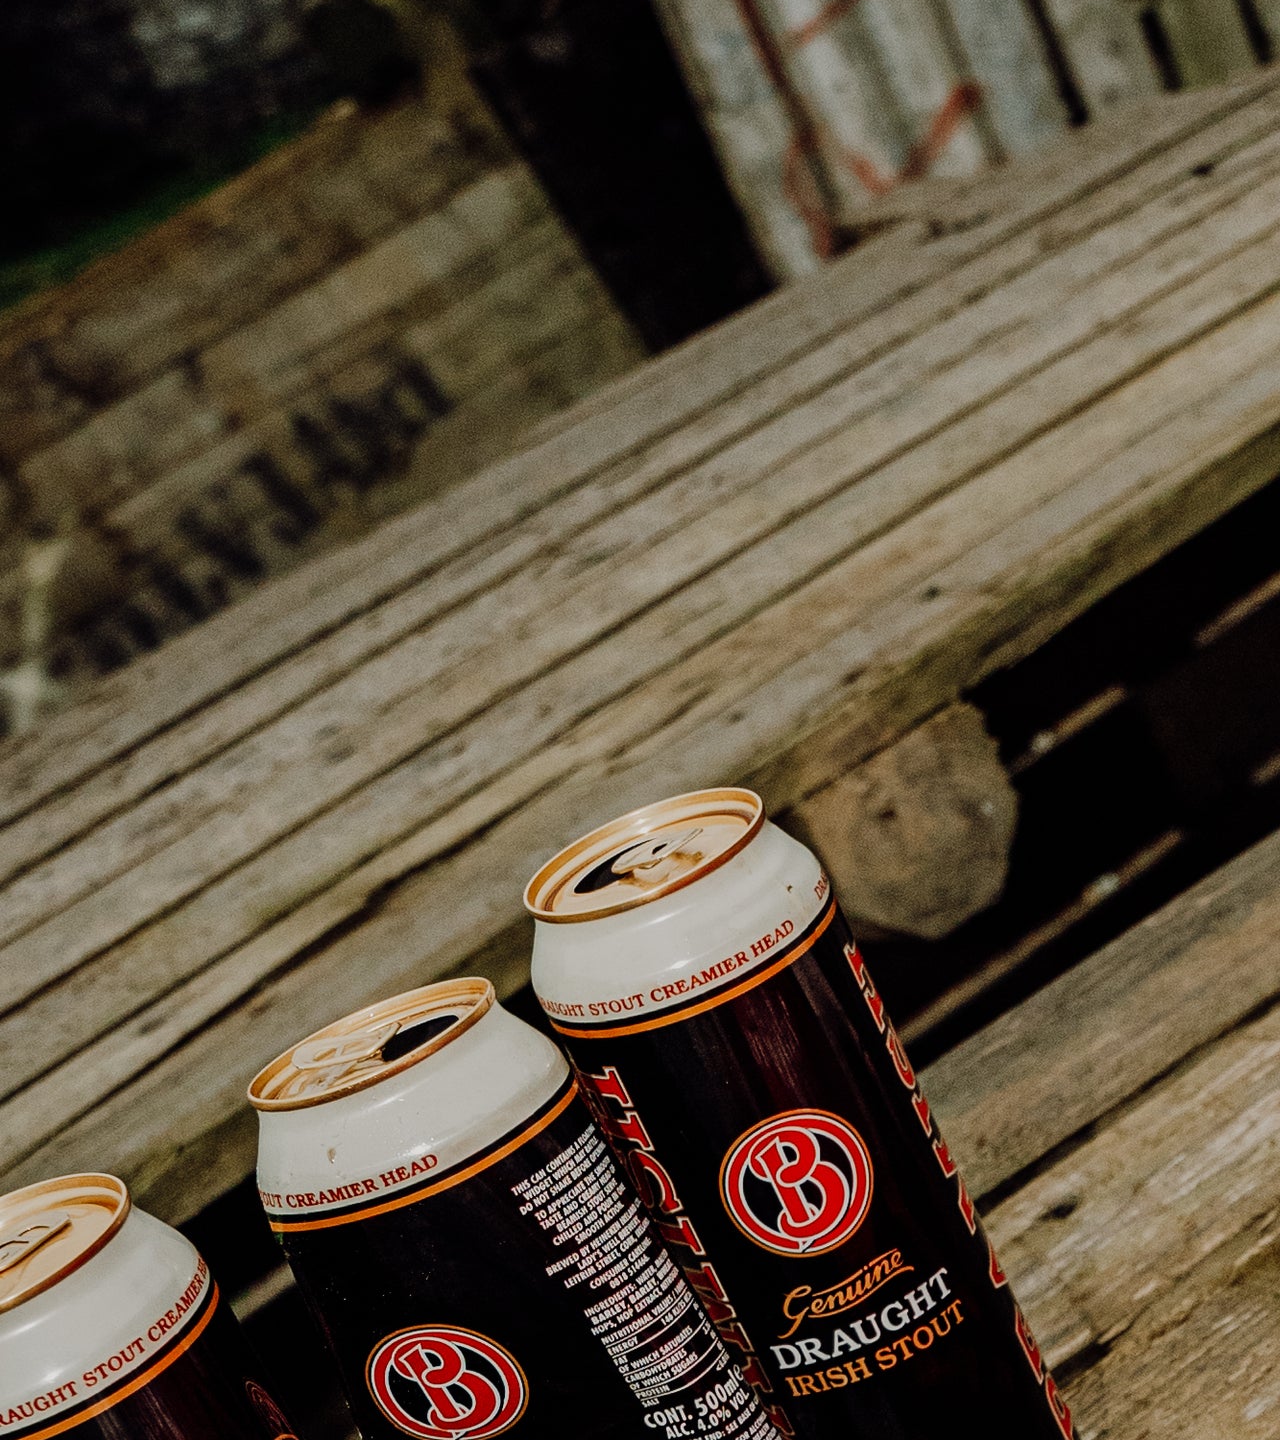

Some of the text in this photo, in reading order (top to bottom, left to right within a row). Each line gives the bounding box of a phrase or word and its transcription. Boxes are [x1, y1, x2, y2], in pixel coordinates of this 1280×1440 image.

[588, 993, 645, 1017] STOUT
[650, 951, 749, 1003] CREAMIER
[750, 919, 794, 958] HEAD
[260, 1154, 439, 1208] OUT CREAMIER HEAD
[512, 1180, 531, 1196] THIS
[529, 1169, 546, 1183] CAN
[545, 1146, 576, 1173] CONTAINS
[574, 1142, 580, 1150] A
[519, 1203, 534, 1215] DO
[533, 1191, 551, 1207] NOT
[549, 1176, 573, 1196] SHAKE
[571, 1159, 592, 1180] BEFORE
[523, 1177, 553, 1200] WIDGET
[552, 1159, 576, 1180] WHICH
[574, 1150, 586, 1163] MAY
[535, 1210, 547, 1221] TO
[547, 1182, 586, 1214] APPRECIATE
[584, 1172, 596, 1185] THE
[541, 1212, 562, 1230] TASTE
[562, 1200, 579, 1216] AND
[578, 1181, 601, 1204] CREAMY
[556, 1206, 588, 1232] BEAMISH
[587, 1191, 606, 1210] STOUT
[553, 1223, 583, 1247] CHILLED
[583, 1211, 598, 1225] AND
[597, 1198, 614, 1214] POUR
[575, 1219, 604, 1244] SMOOTH
[545, 1252, 580, 1277] BREWED
[579, 1245, 591, 1256] BY
[590, 1221, 622, 1249] HEINEKEN
[564, 1264, 596, 1288] LEITRIM
[595, 1248, 622, 1270] STREET,
[577, 1250, 603, 1270] LADY'S
[602, 1237, 620, 1252] WELL
[589, 1258, 629, 1290] CONSUMER
[778, 1248, 914, 1339] Genuine
[584, 1282, 637, 1318] INGREDIENTS:
[591, 1300, 630, 1326] BARLEY,
[629, 1277, 659, 1303] BARLEY,
[591, 1319, 617, 1336] HOPS,
[616, 1308, 635, 1323] HOP
[601, 1313, 653, 1345] NUTRITIONAL
[652, 1295, 674, 1316] VALUES
[770, 1267, 951, 1370] DRAUGHT
[82, 1337, 146, 1387] STOUT
[147, 1274, 204, 1343] CREAMIER
[608, 1337, 639, 1356] ENERGY
[661, 1313, 673, 1325] 146
[618, 1365, 630, 1373] OF
[631, 1350, 660, 1369] WHICH
[659, 1326, 693, 1355] SATURATES
[785, 1299, 964, 1397] IRISH STOUT
[613, 1356, 628, 1366] FAT
[625, 1348, 688, 1383] CARBOHYDRATES
[629, 1382, 640, 1391] OF
[642, 1370, 671, 1387] WHICH
[671, 1351, 698, 1376] SUGARS
[634, 1384, 670, 1400] PROTEIN
[643, 1404, 693, 1428] CONT.
[694, 1368, 739, 1417] 500ml
[665, 1422, 694, 1440] ALC.
[697, 1406, 731, 1431] 4.0%
[729, 1388, 750, 1411] VOL
[725, 1423, 739, 1434] SEE
[738, 1409, 752, 1425] BASE
